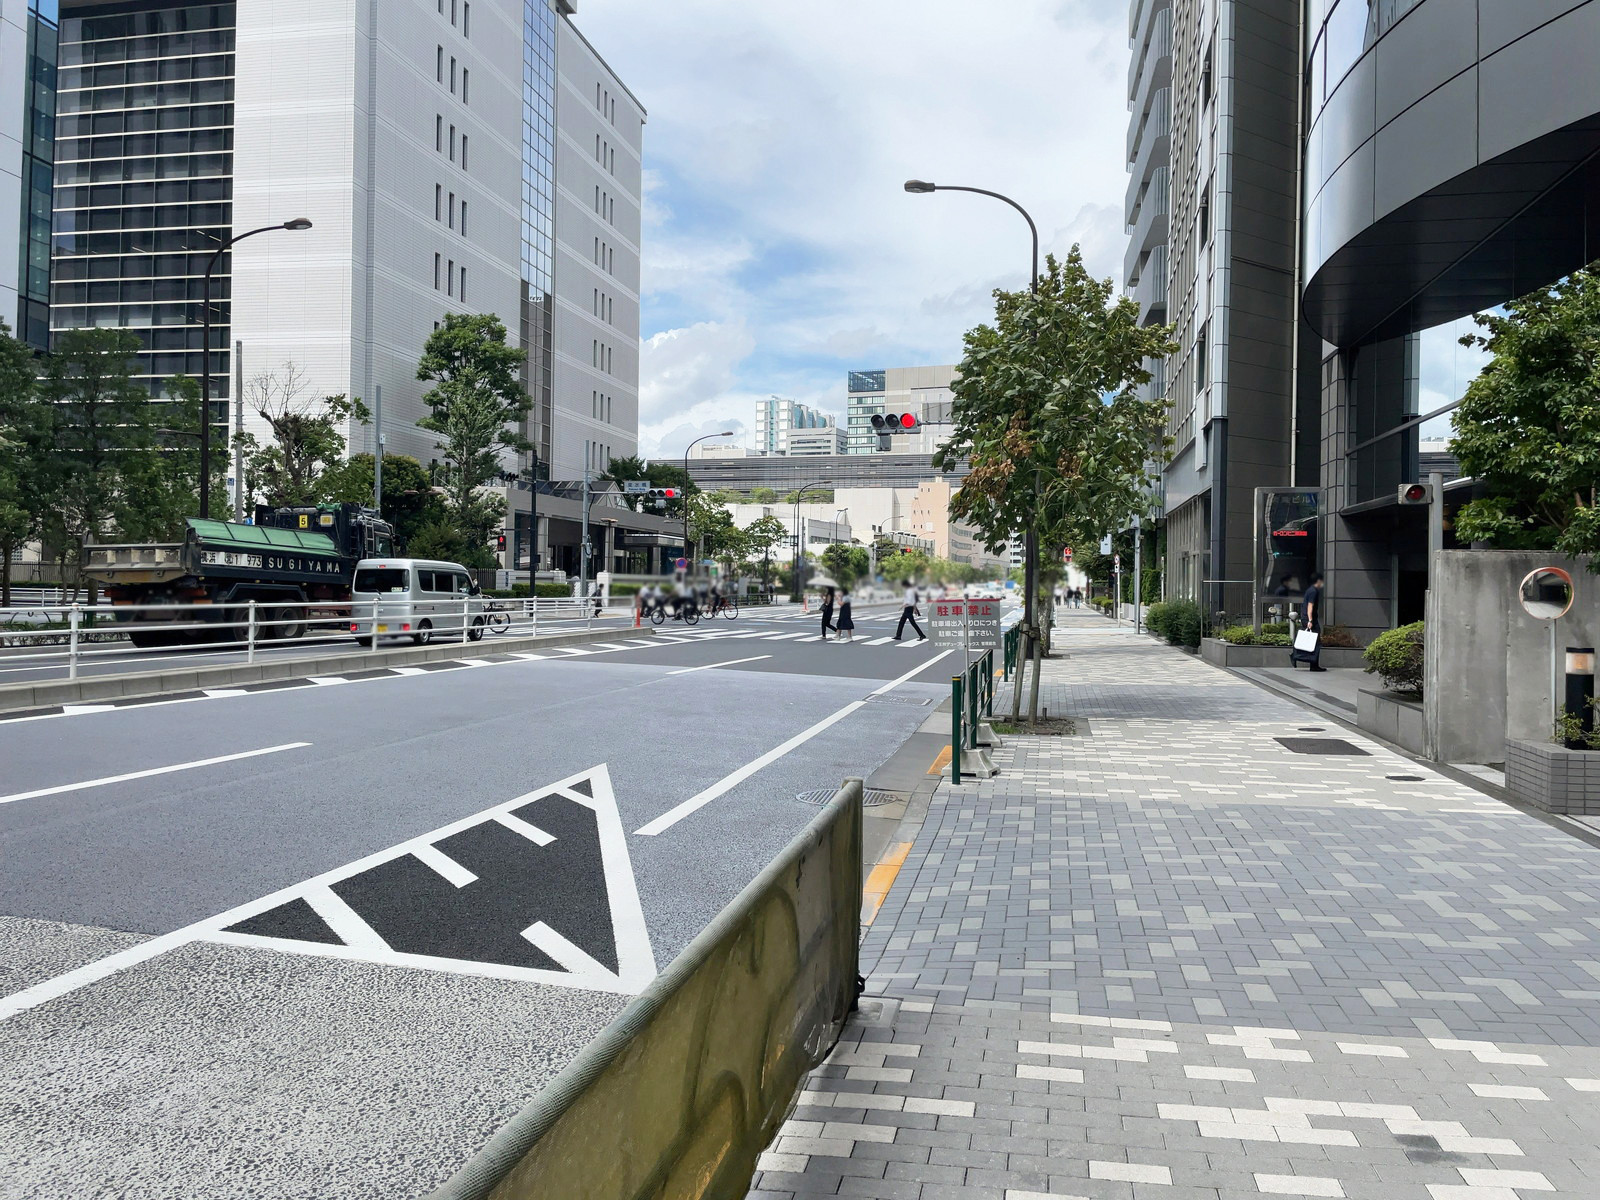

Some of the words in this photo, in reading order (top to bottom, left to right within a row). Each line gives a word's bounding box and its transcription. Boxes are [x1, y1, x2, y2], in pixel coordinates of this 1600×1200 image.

[301, 517, 306, 525] 5
[937, 605, 992, 616] 駐車禁止
